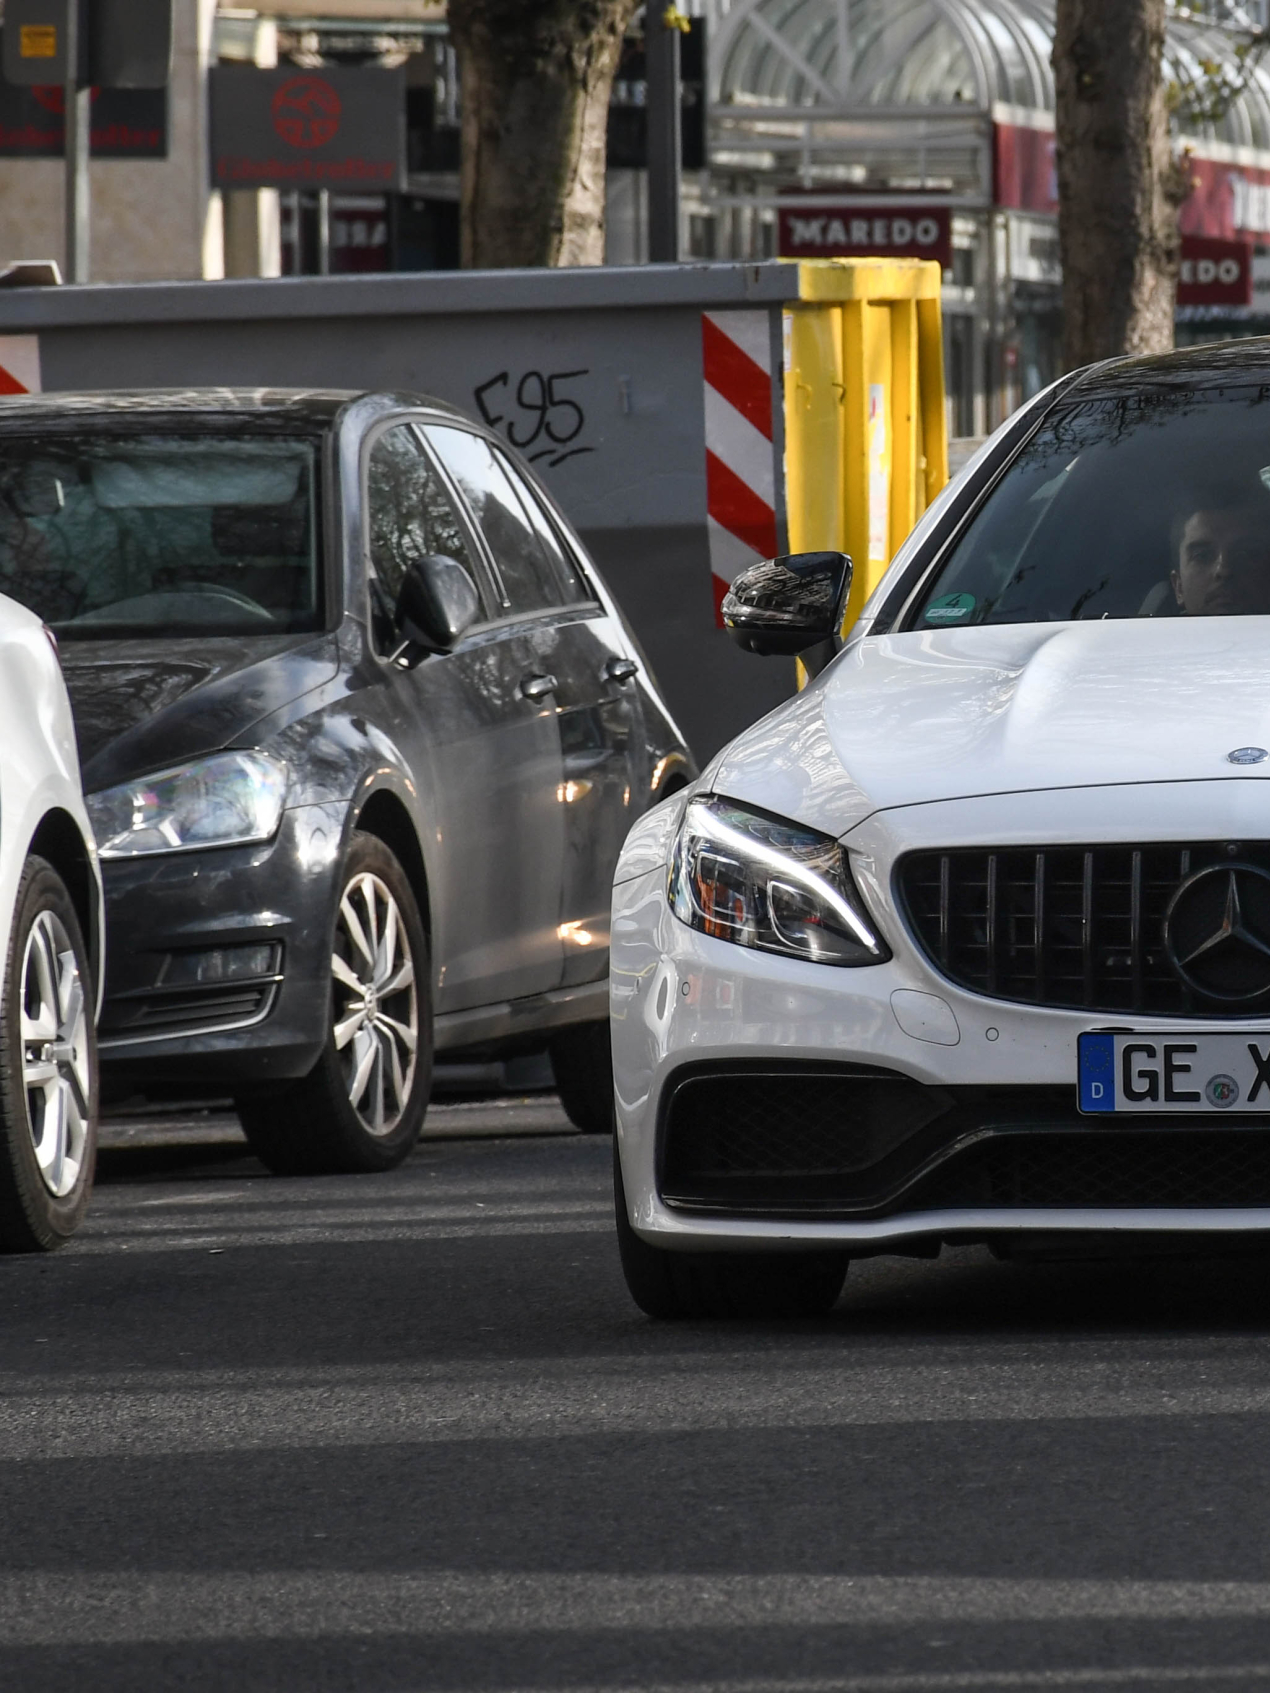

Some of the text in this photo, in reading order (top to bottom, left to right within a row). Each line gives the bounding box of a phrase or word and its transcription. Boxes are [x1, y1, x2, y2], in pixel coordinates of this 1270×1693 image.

[787, 217, 939, 246] MAREDO
[1180, 258, 1240, 286] EDO
[945, 593, 963, 608] 4
[1122, 1043, 1201, 1102] GE
[1091, 1082, 1104, 1099] D
